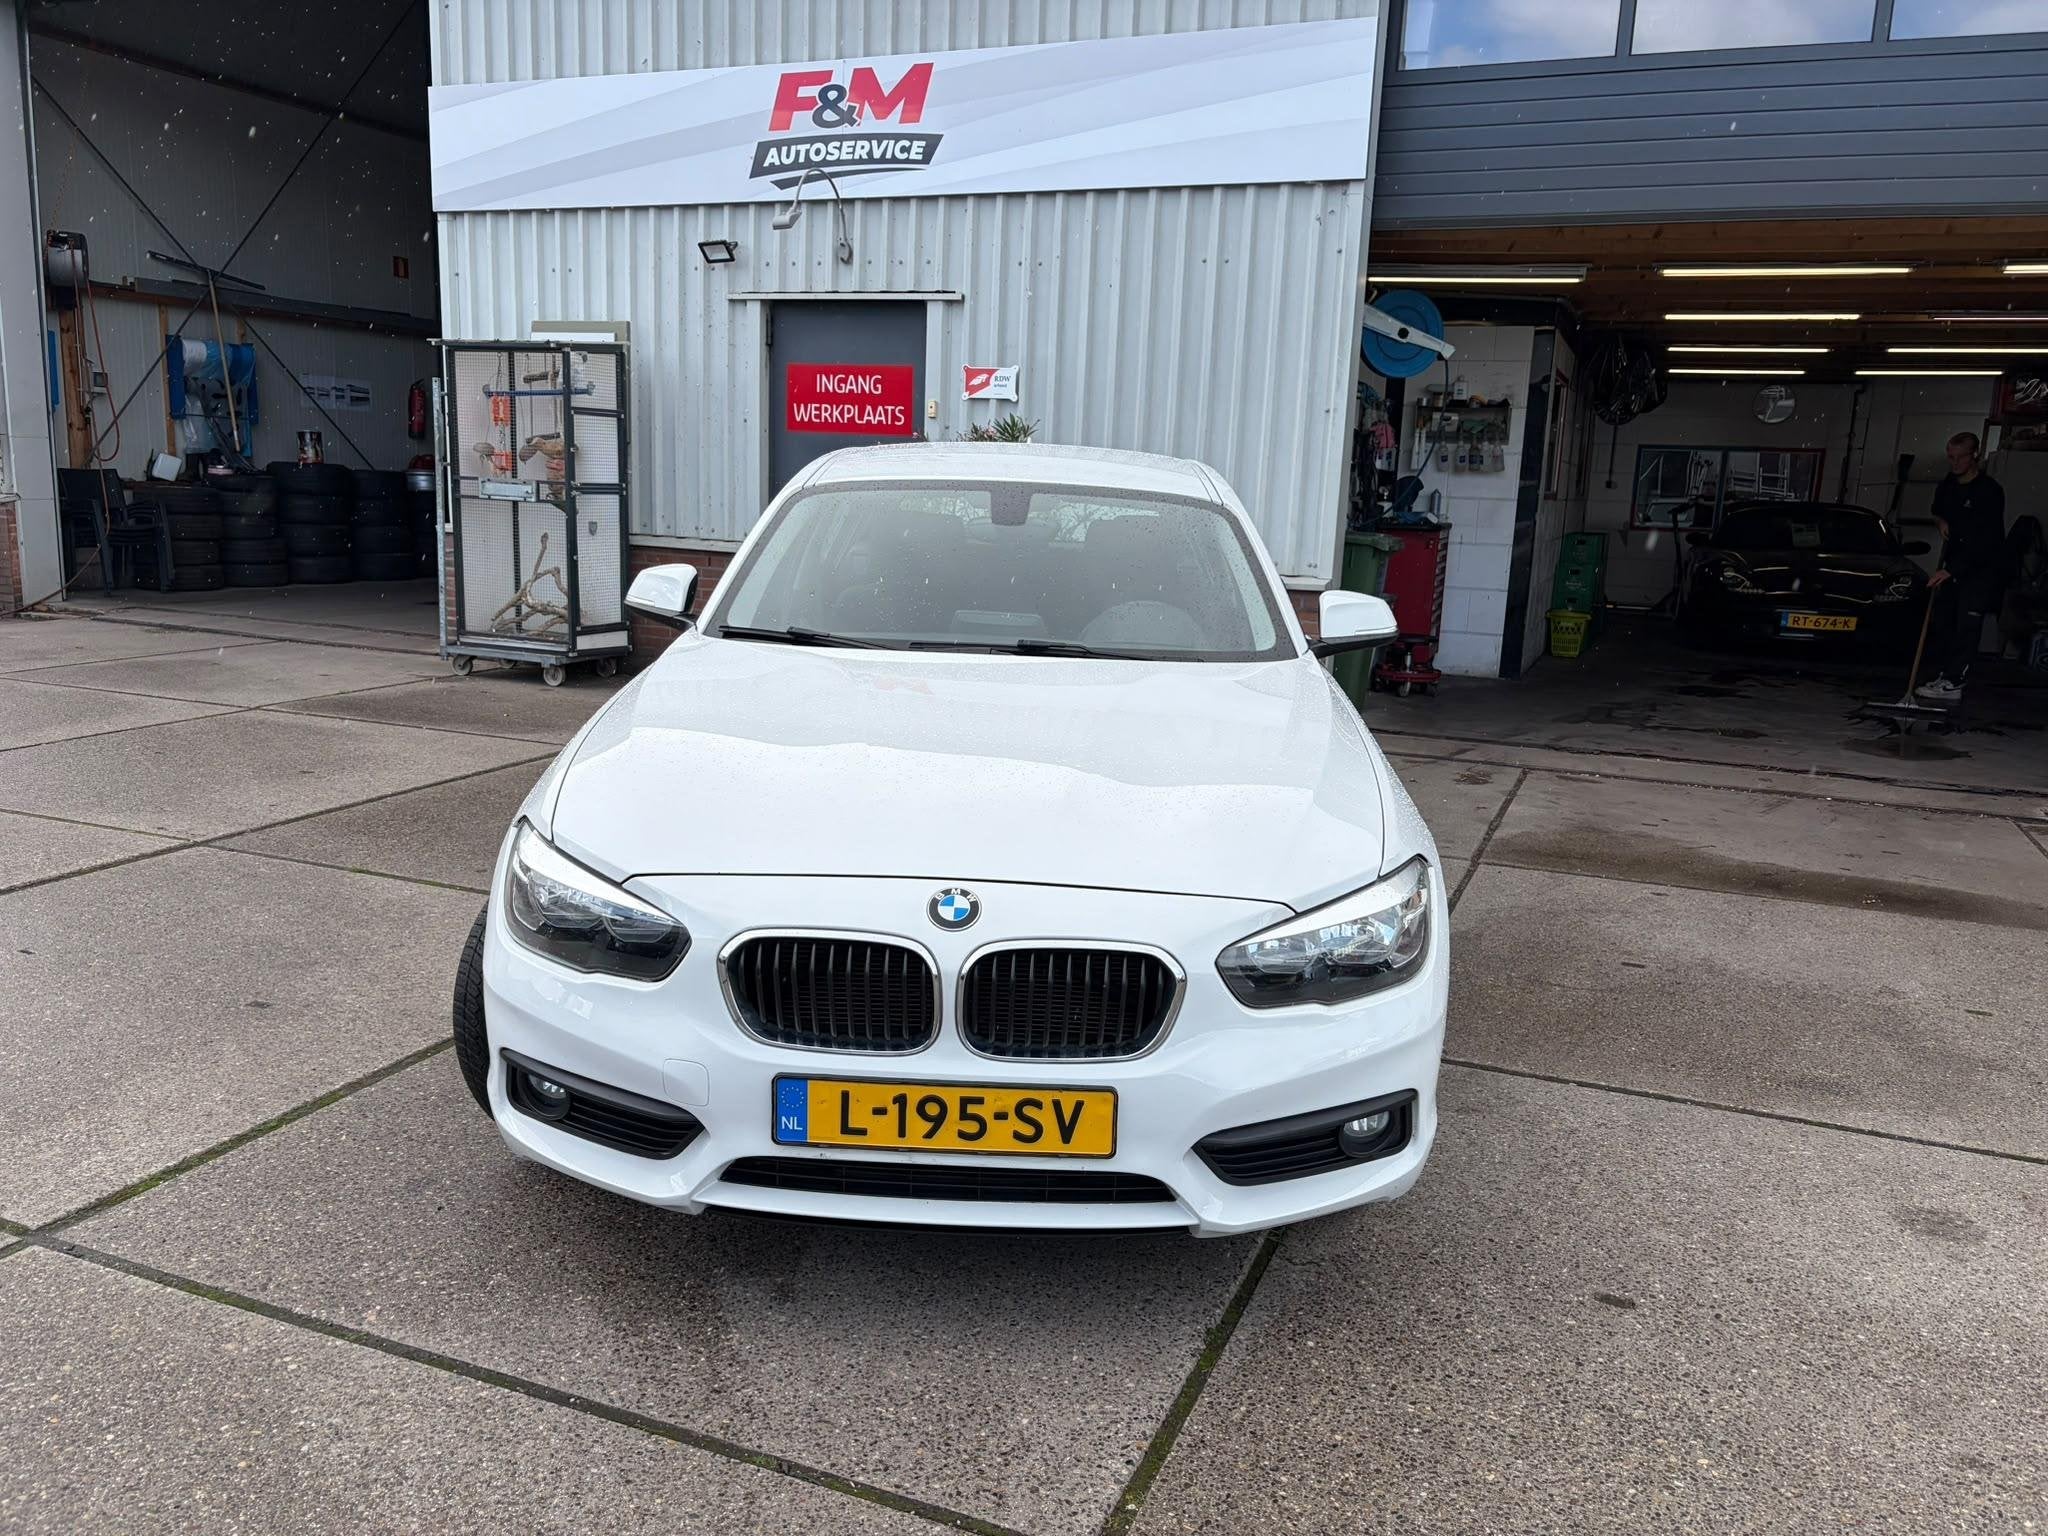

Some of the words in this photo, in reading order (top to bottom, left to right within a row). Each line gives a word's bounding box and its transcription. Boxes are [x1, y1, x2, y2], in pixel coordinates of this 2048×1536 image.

[768, 62, 934, 131] F&M
[763, 139, 926, 168] AUTOSERVICE
[816, 373, 882, 395] INGANG
[793, 402, 905, 426] WERKPLAATS
[935, 888, 977, 902] BMW
[781, 1115, 803, 1131] NL
[840, 1089, 1085, 1145] L-195-SV
